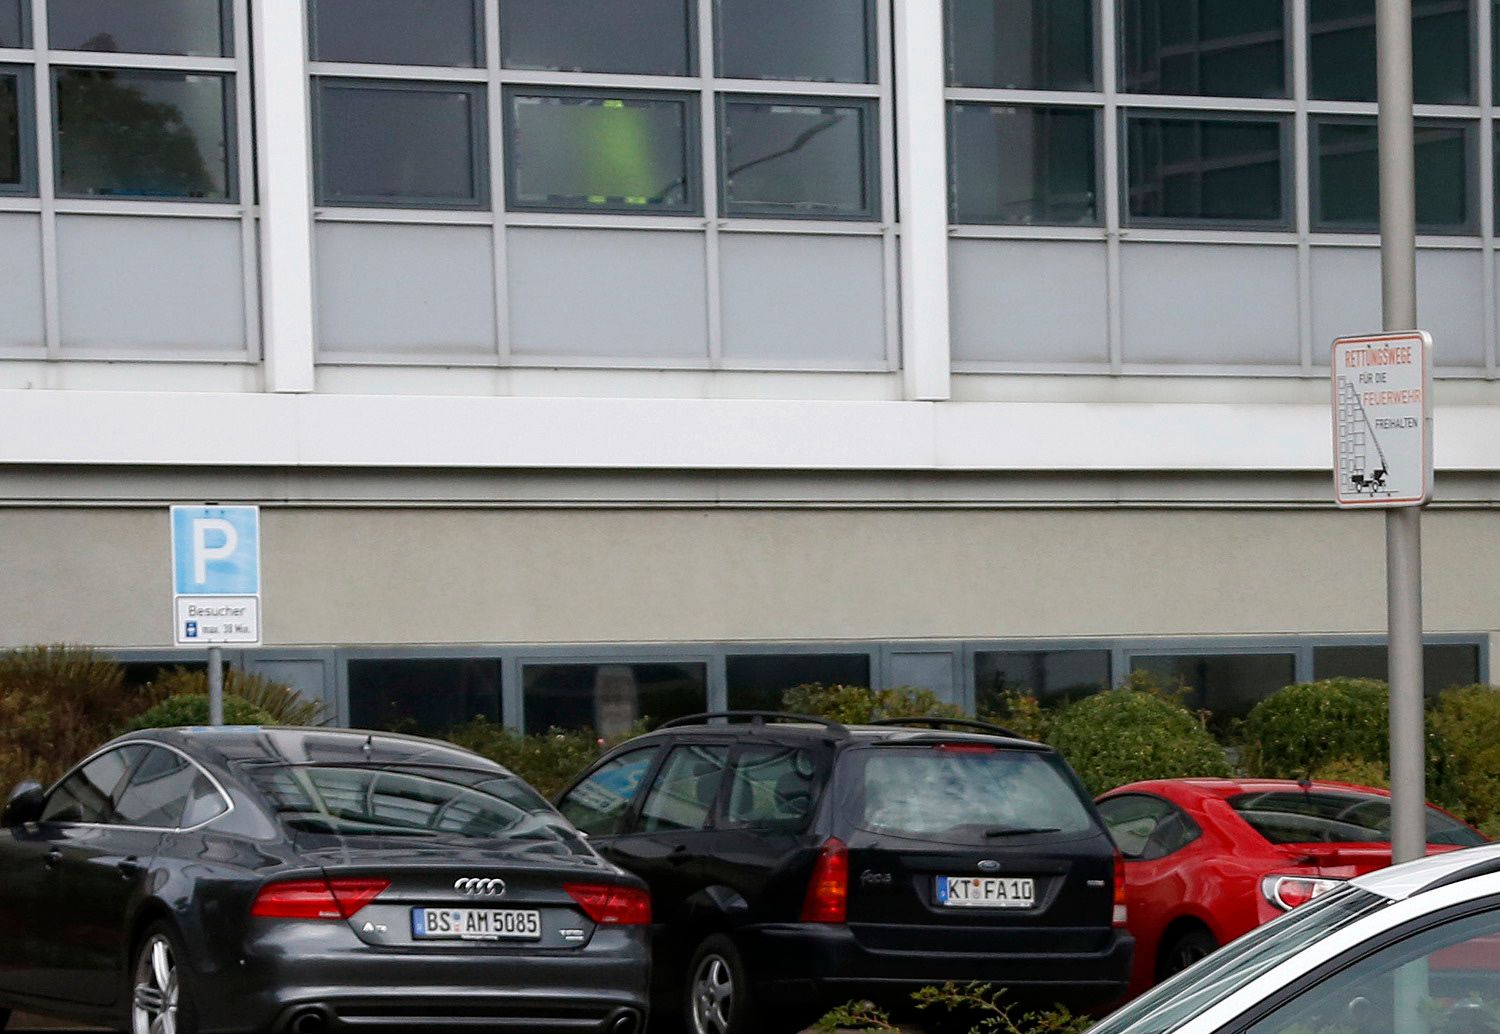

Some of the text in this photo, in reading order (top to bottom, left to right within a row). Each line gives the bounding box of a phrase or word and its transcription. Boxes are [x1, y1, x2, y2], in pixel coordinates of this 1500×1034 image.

[1345, 347, 1412, 368] RETTUNGSWEGE
[1375, 372, 1387, 383] DIE
[1363, 389, 1420, 406] FEUERWEHR
[1375, 417, 1418, 430] FREIHALTEN
[193, 518, 238, 584] P
[188, 605, 246, 617] Besucher
[949, 879, 1032, 899] KT FA 10
[426, 911, 538, 933] BS AM 5085
